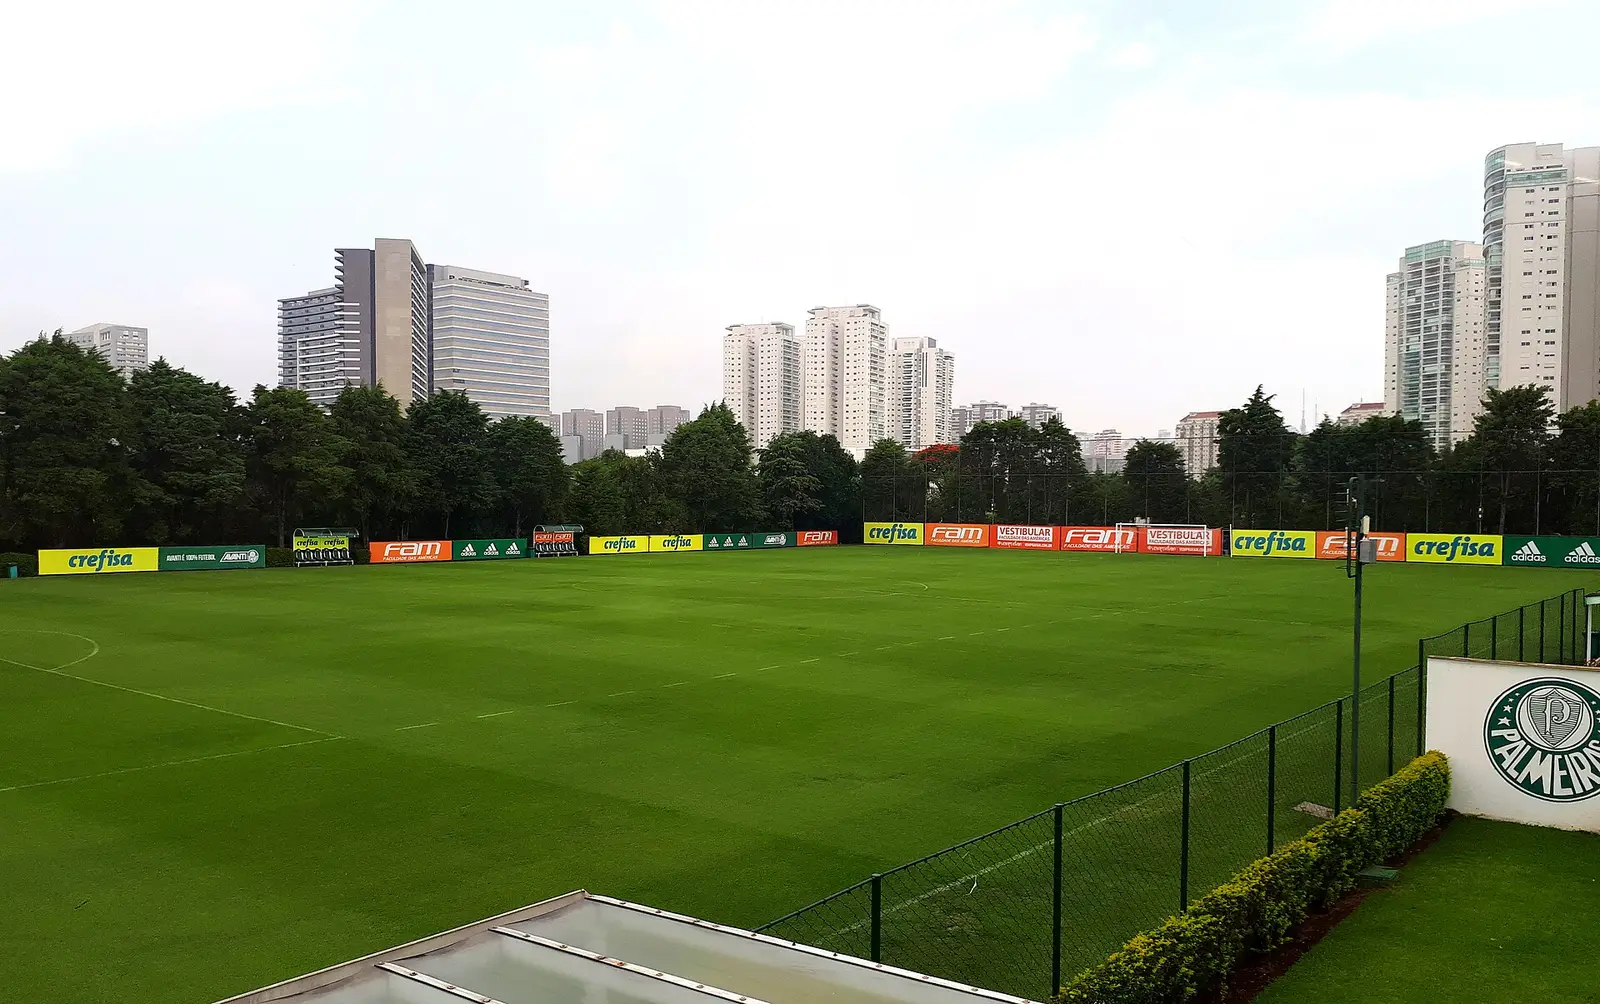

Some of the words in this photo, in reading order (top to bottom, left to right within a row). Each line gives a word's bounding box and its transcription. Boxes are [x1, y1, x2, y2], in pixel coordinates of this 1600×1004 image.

[869, 524, 917, 543] crefisa
[999, 527, 1050, 536] VESTIBULAR
[1149, 530, 1209, 540] VESTIBULAR
[296, 539, 318, 547] crefisa
[324, 537, 344, 546] crefisa
[604, 537, 636, 552] crefisa
[662, 535, 691, 550] crefisa
[1234, 531, 1306, 555] crefisa
[1414, 536, 1494, 561] crefisa
[68, 549, 132, 571] crefisa
[1511, 553, 1547, 562] adidas
[1564, 554, 1600, 563] adidas
[1542, 698, 1571, 737] P
